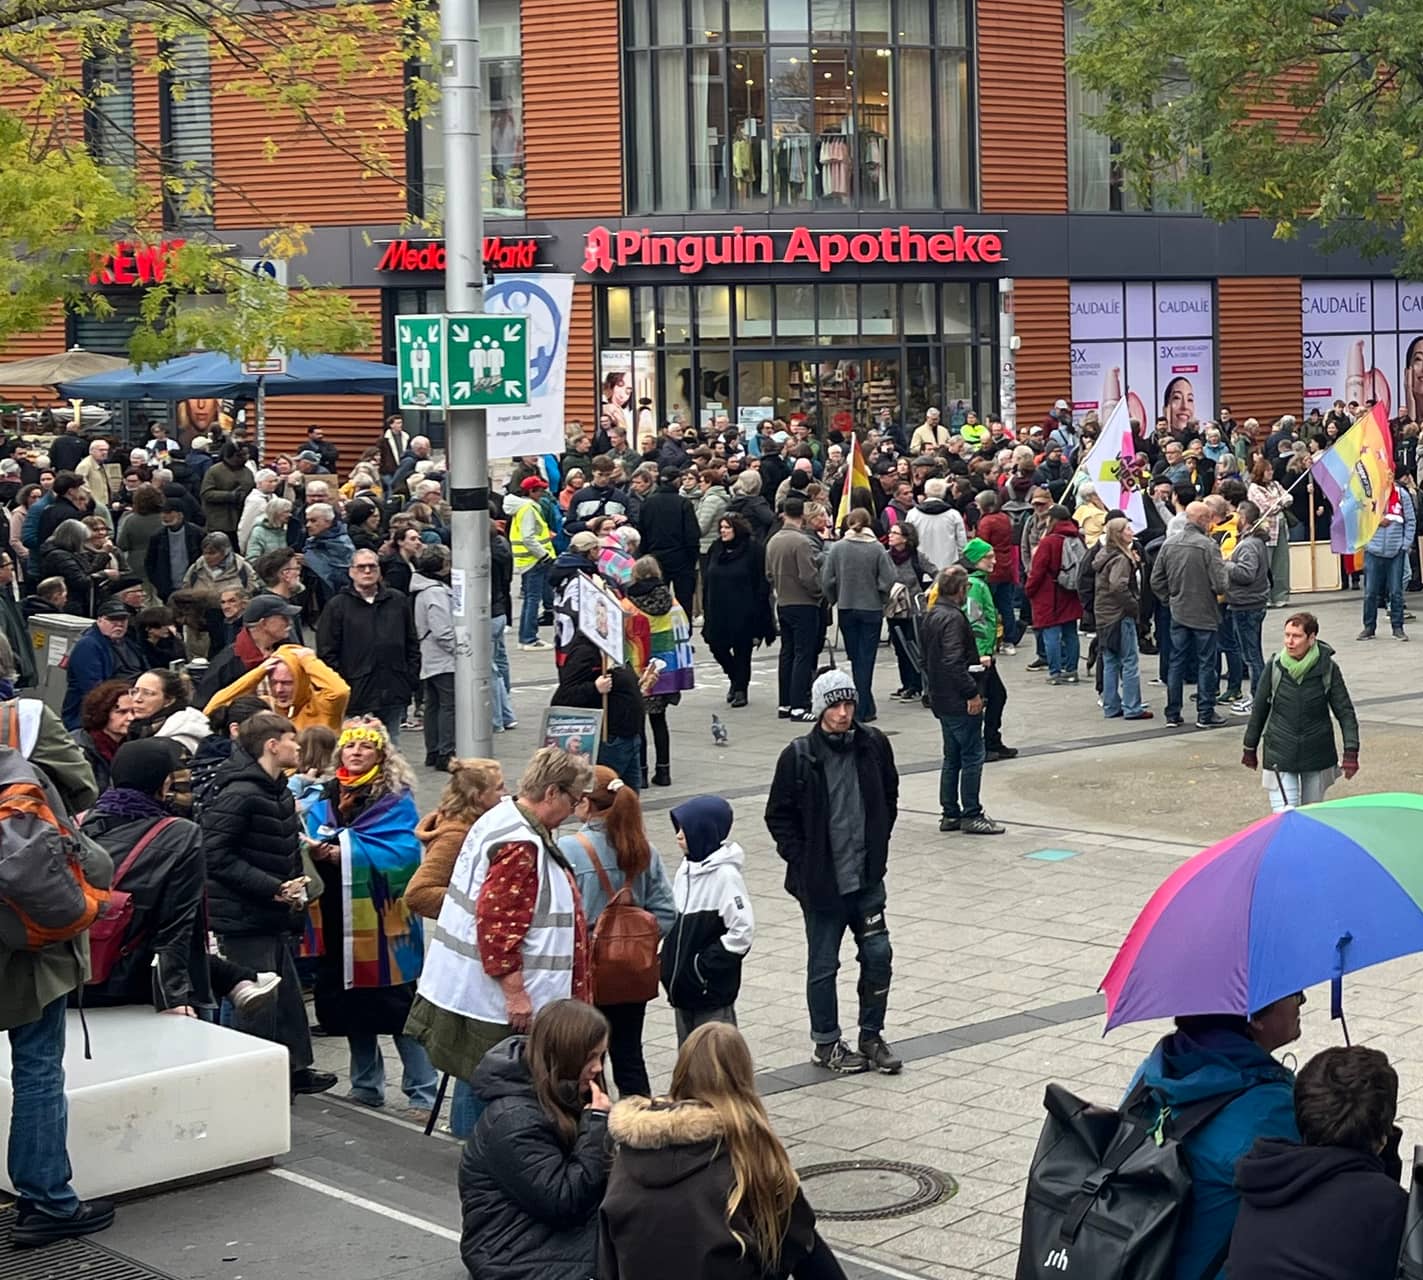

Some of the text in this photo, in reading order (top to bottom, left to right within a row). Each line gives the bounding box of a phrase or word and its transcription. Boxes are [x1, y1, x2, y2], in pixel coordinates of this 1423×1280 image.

[617, 226, 773, 274] Pinguin
[784, 225, 1002, 273] Apotheke
[1160, 346, 1174, 359] 3X
[1304, 341, 1323, 360] 3X
